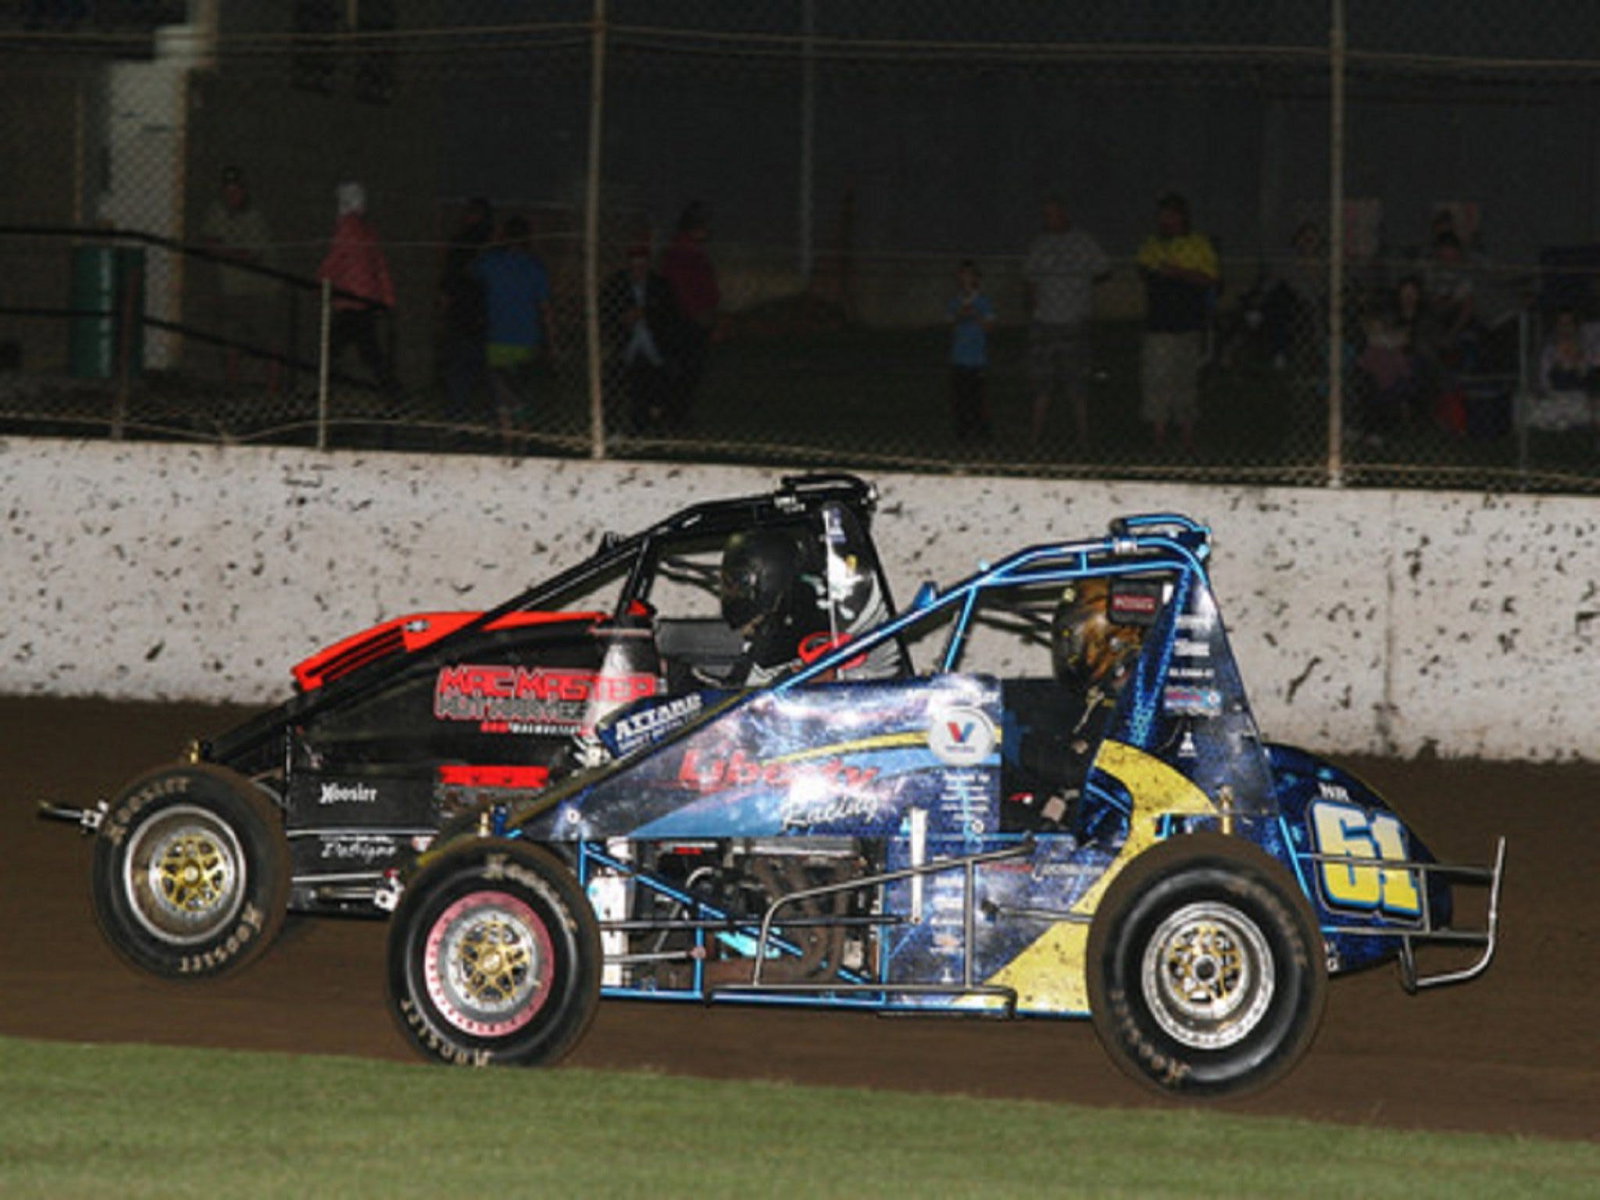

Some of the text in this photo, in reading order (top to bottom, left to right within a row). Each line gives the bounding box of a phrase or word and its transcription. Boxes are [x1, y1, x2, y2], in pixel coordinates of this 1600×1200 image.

[319, 782, 378, 804] Hoosier
[678, 744, 882, 796] Libety
[1312, 800, 1423, 917] 61
